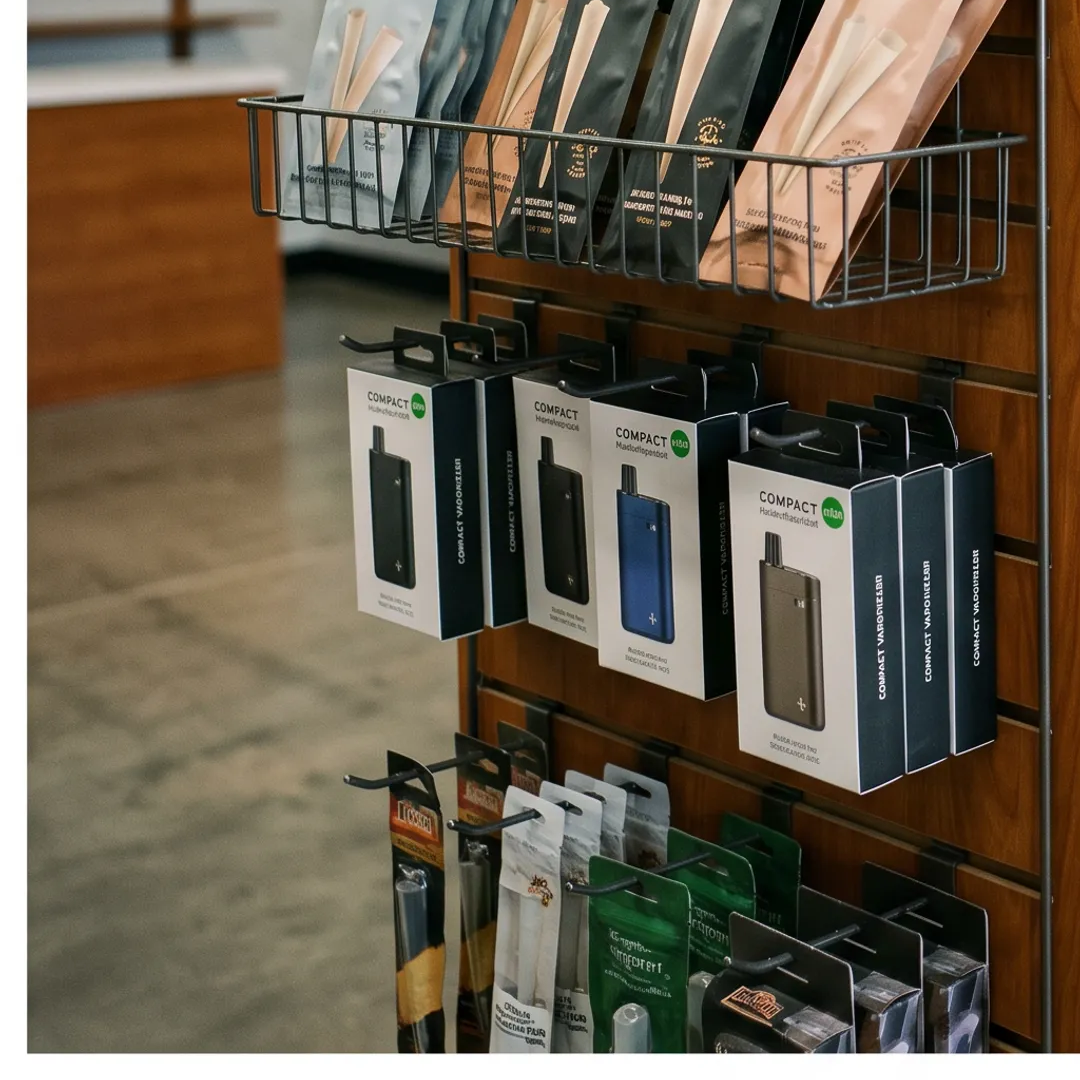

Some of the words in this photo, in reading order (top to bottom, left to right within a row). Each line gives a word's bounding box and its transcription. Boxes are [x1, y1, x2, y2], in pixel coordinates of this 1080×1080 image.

[367, 391, 409, 410] COMPACT
[534, 401, 578, 420] COMPACT
[616, 427, 668, 448] COMPACT
[759, 491, 818, 515] COMPACT
